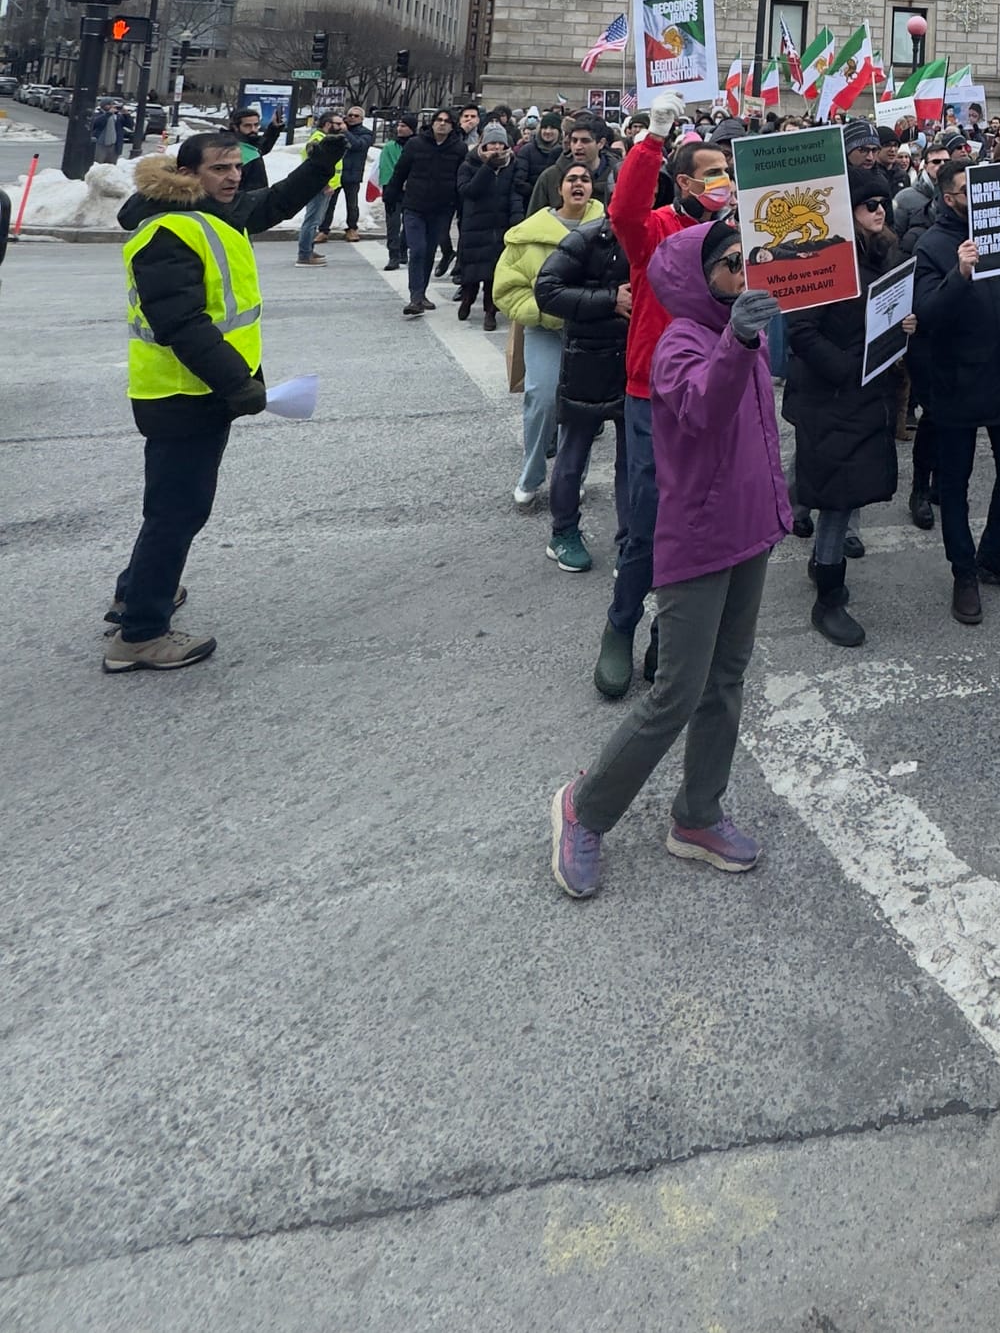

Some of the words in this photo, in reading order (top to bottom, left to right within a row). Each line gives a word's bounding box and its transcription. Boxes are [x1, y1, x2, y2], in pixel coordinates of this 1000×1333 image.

[670, 10, 698, 23] IRAN'S
[651, 68, 699, 84] TRANSITION
[752, 147, 776, 158] What
[789, 143, 800, 152] we
[800, 139, 825, 150] want?
[754, 159, 787, 171] REGIME
[788, 154, 826, 166] CHANGE!
[971, 184, 982, 194] NO
[983, 181, 1000, 192] DEAL
[972, 192, 992, 204] WITH
[973, 207, 1000, 219] REGIME
[974, 219, 988, 230] FOR
[974, 235, 992, 245] REZA
[978, 244, 989, 255] OR
[767, 273, 786, 285] Who
[788, 271, 799, 281] do
[800, 270, 812, 278] we
[813, 264, 837, 276] want?
[772, 287, 795, 298] REZA
